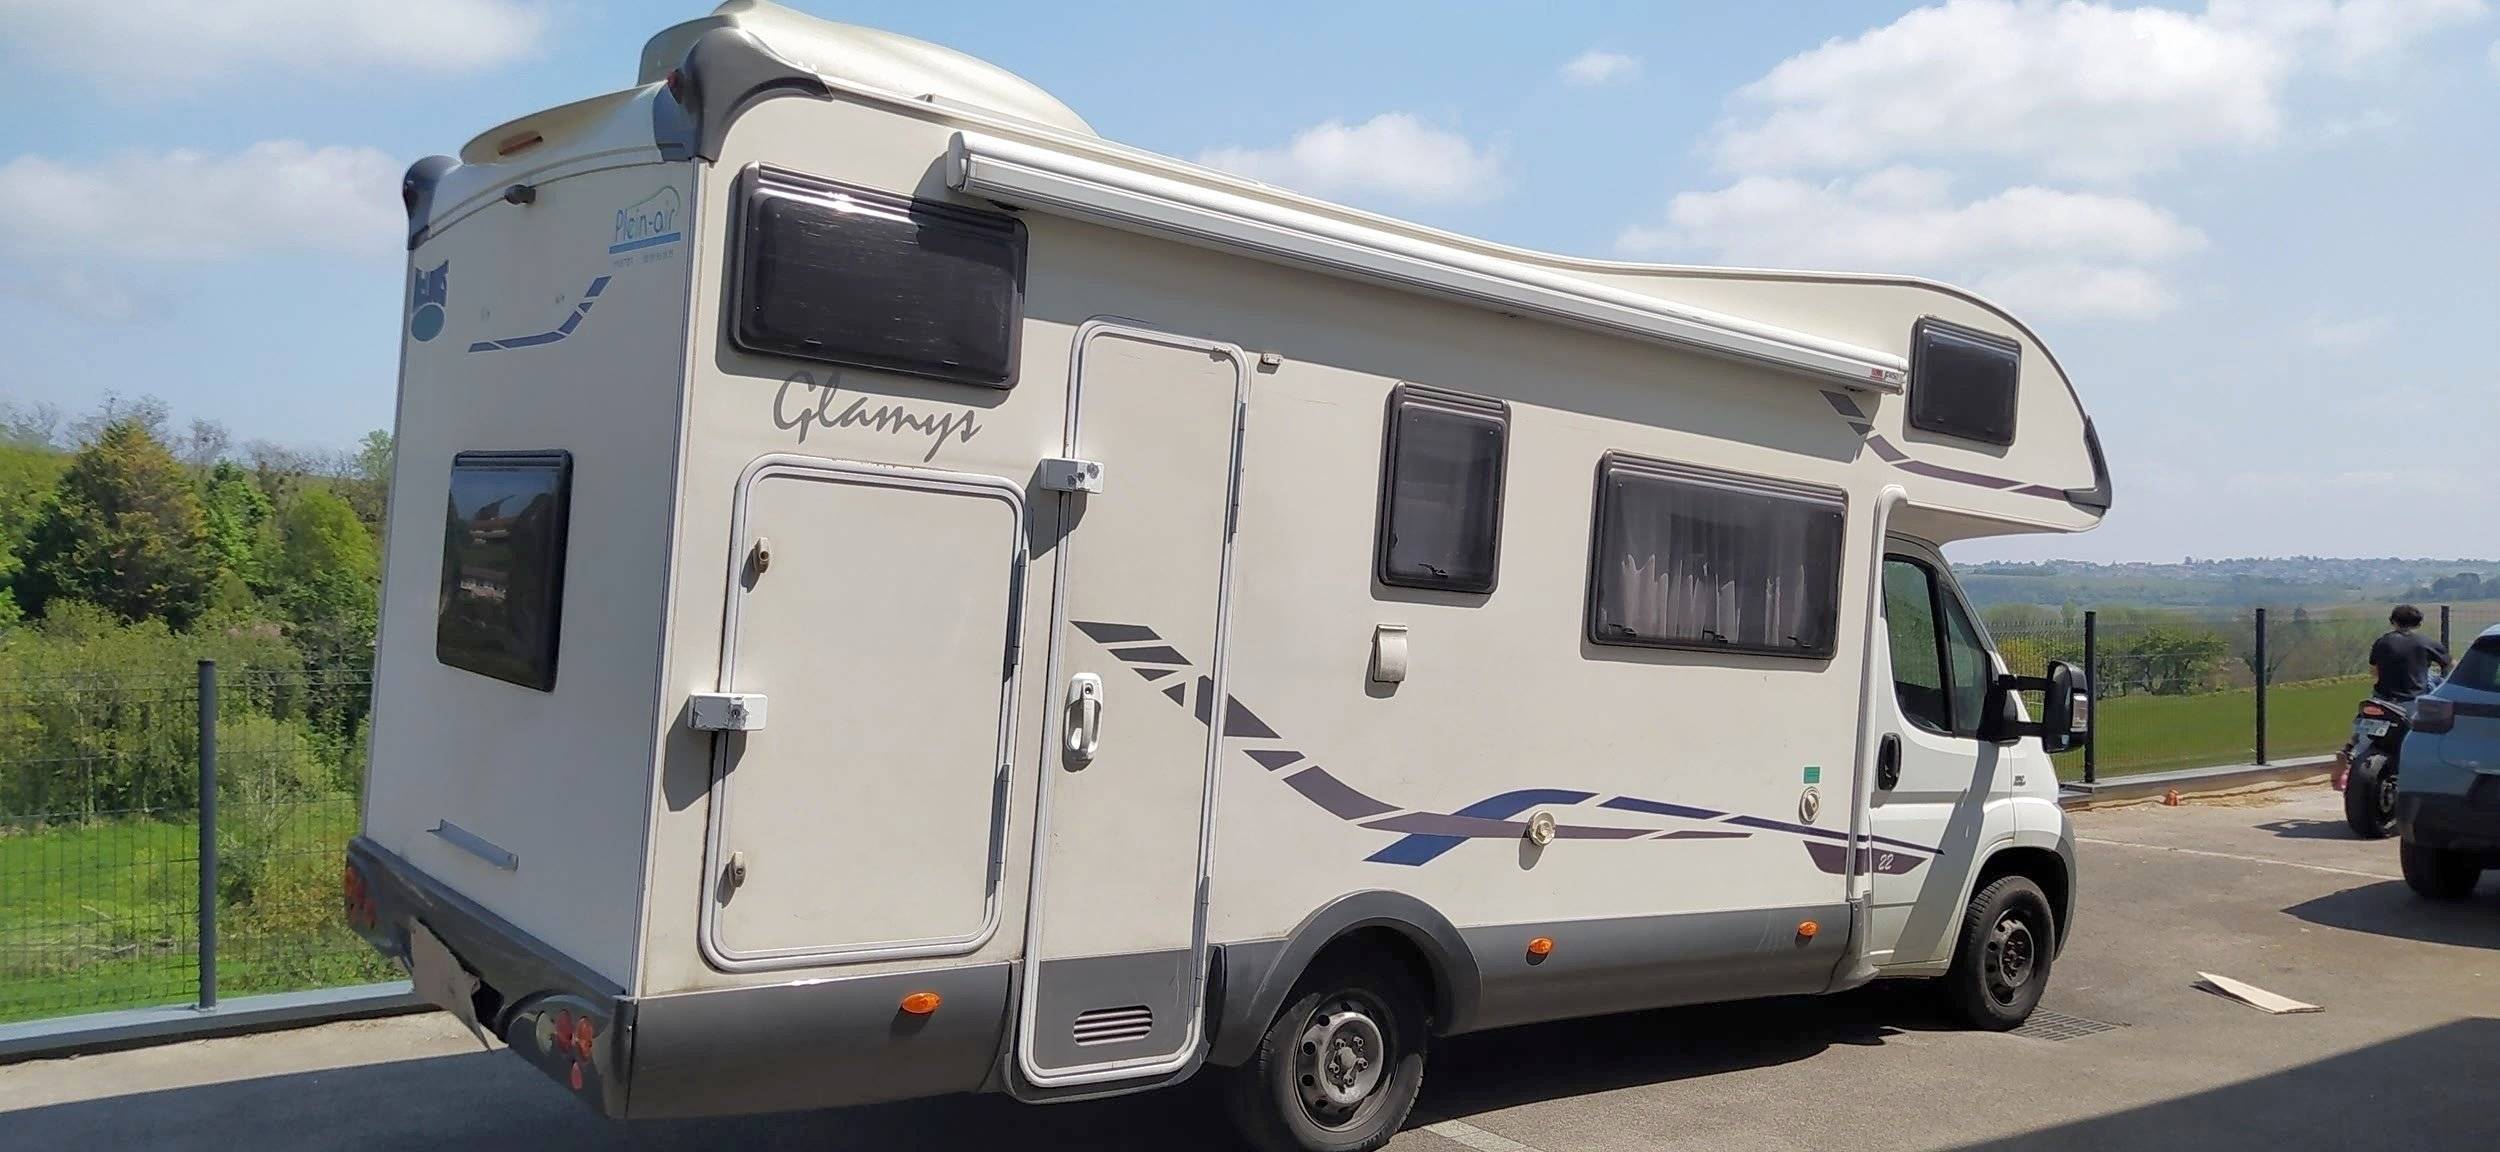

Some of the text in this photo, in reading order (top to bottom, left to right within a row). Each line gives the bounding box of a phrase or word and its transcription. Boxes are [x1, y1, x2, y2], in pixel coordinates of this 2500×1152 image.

[614, 202, 677, 242] Plein-air
[772, 367, 983, 463] Glamys
[1877, 853, 1894, 871] 22
